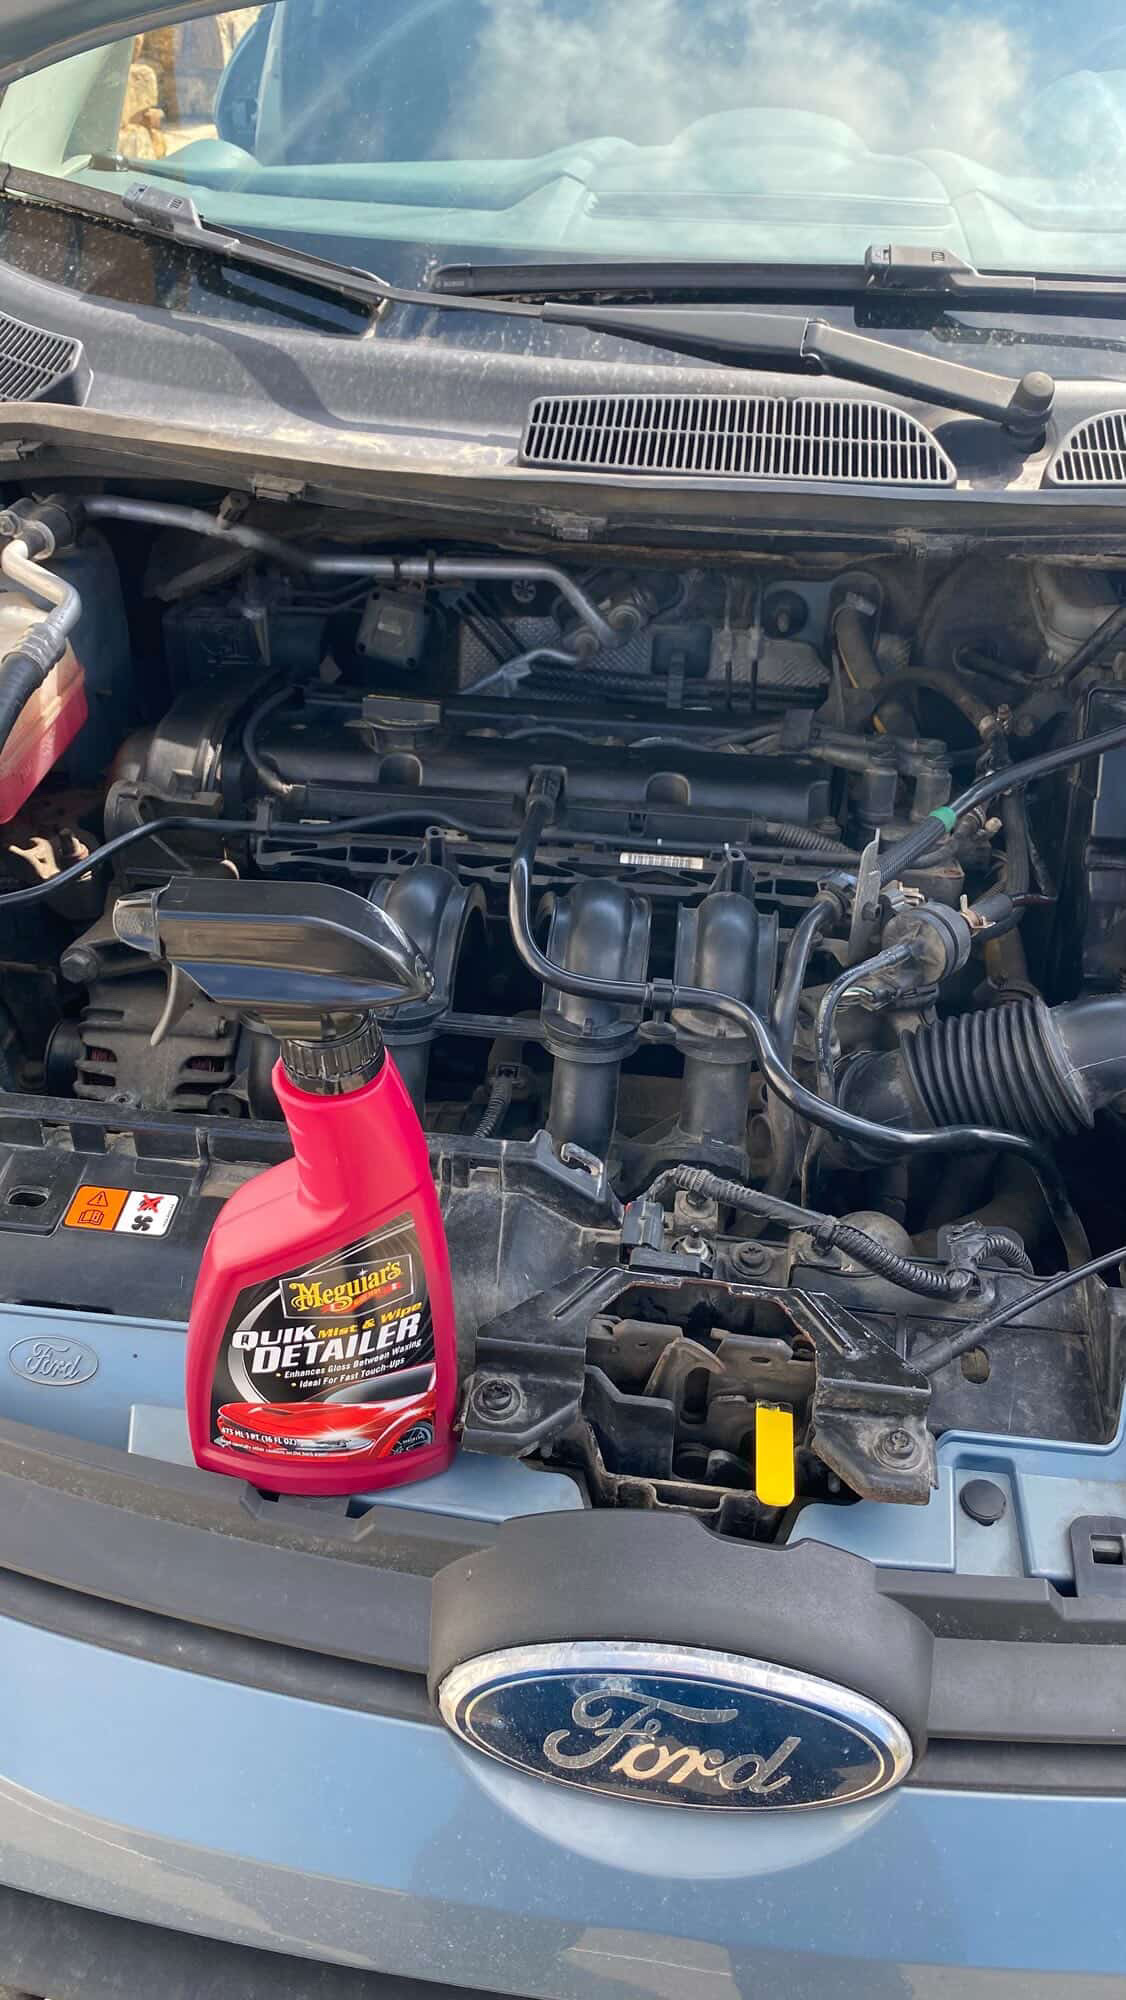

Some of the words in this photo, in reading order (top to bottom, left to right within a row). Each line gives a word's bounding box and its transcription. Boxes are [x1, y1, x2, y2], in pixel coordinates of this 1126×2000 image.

[289, 1261, 402, 1312] Meguiar's
[232, 1324, 318, 1351] QUIK
[318, 1324, 358, 1338] Mist
[362, 1318, 376, 1330] &
[381, 1302, 422, 1324] Wipe
[25, 1342, 83, 1379] Ford
[252, 1312, 421, 1373] DETAILER
[284, 1367, 326, 1380] Enhances
[328, 1362, 351, 1374] Gloss
[353, 1351, 390, 1369] Between
[392, 1339, 422, 1357] Waxing
[299, 1378, 321, 1389] Ideal
[323, 1375, 337, 1385] For
[340, 1372, 359, 1382] Fast
[360, 1357, 406, 1378] Touch-Ups
[543, 1689, 801, 1794] Ford
